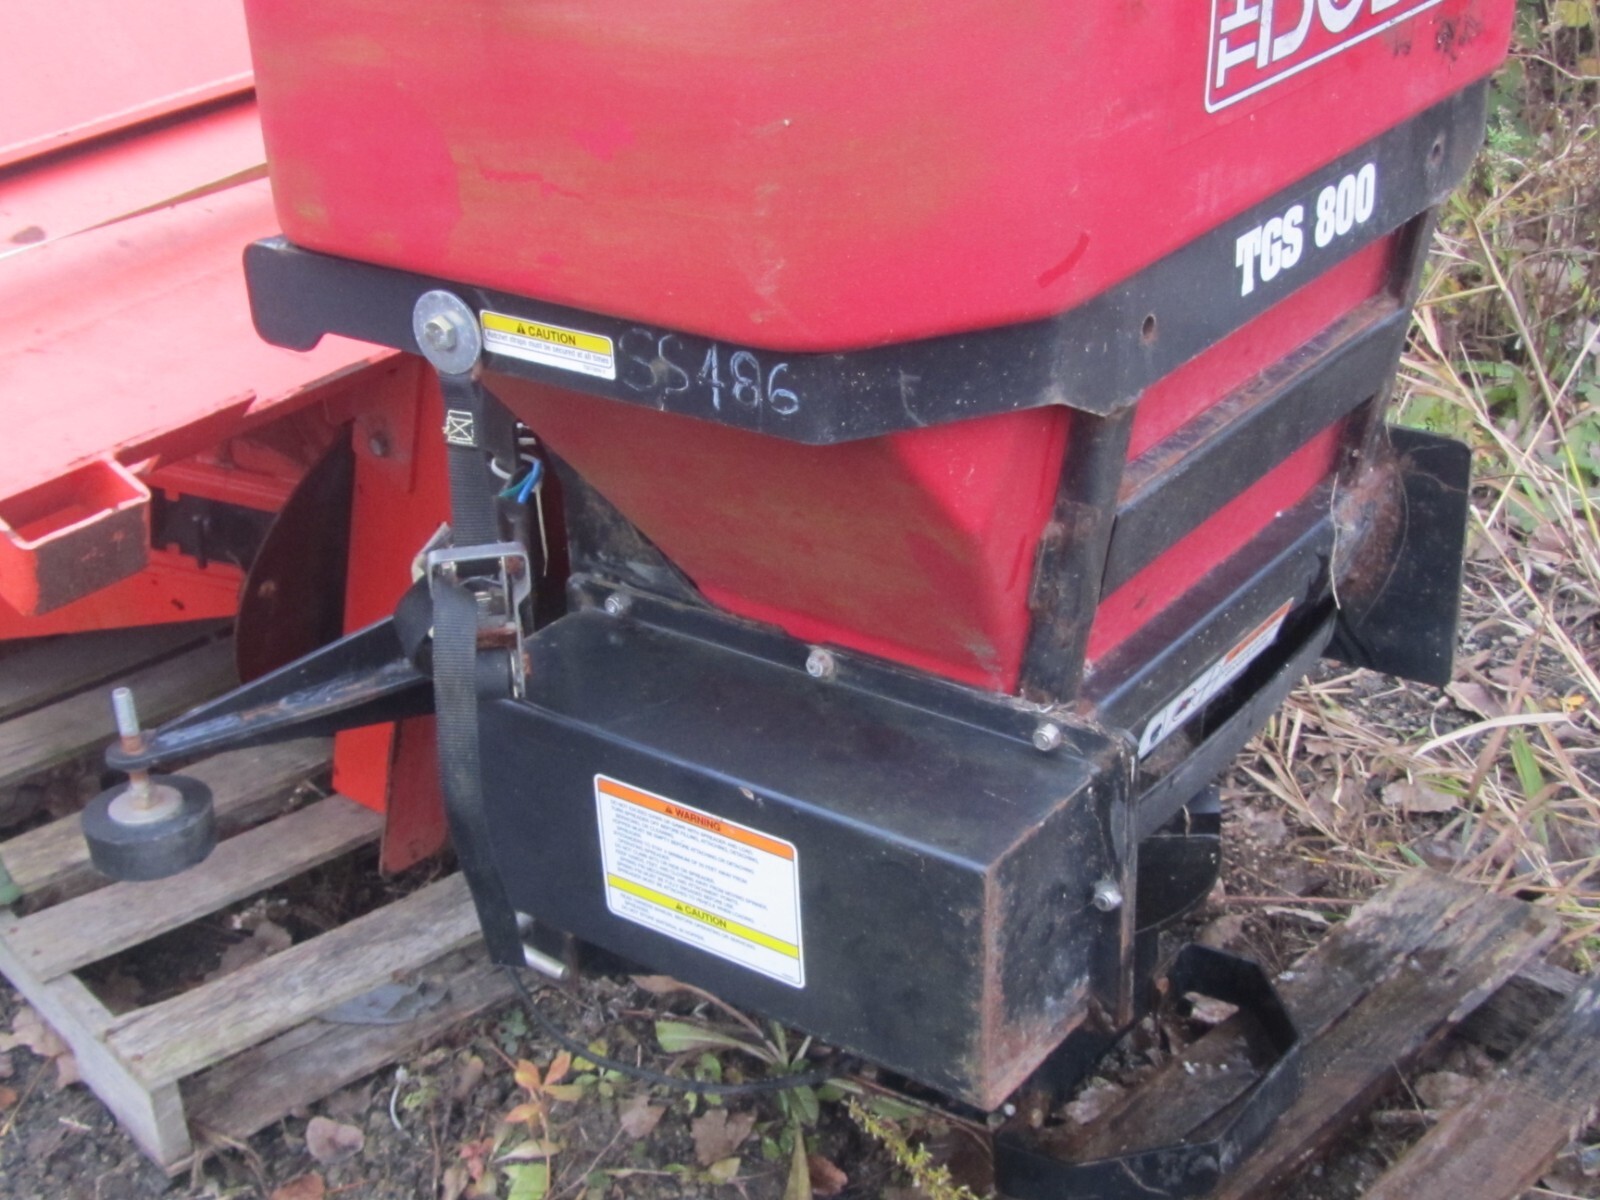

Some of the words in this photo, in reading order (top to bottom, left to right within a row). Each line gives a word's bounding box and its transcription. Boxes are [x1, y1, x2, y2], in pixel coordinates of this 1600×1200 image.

[1236, 205, 1303, 297] TGS
[1315, 163, 1376, 248] 800
[528, 325, 576, 346] CAUTION
[544, 343, 552, 351] be
[674, 807, 720, 832] WARNING
[684, 905, 726, 929] CAUTION
